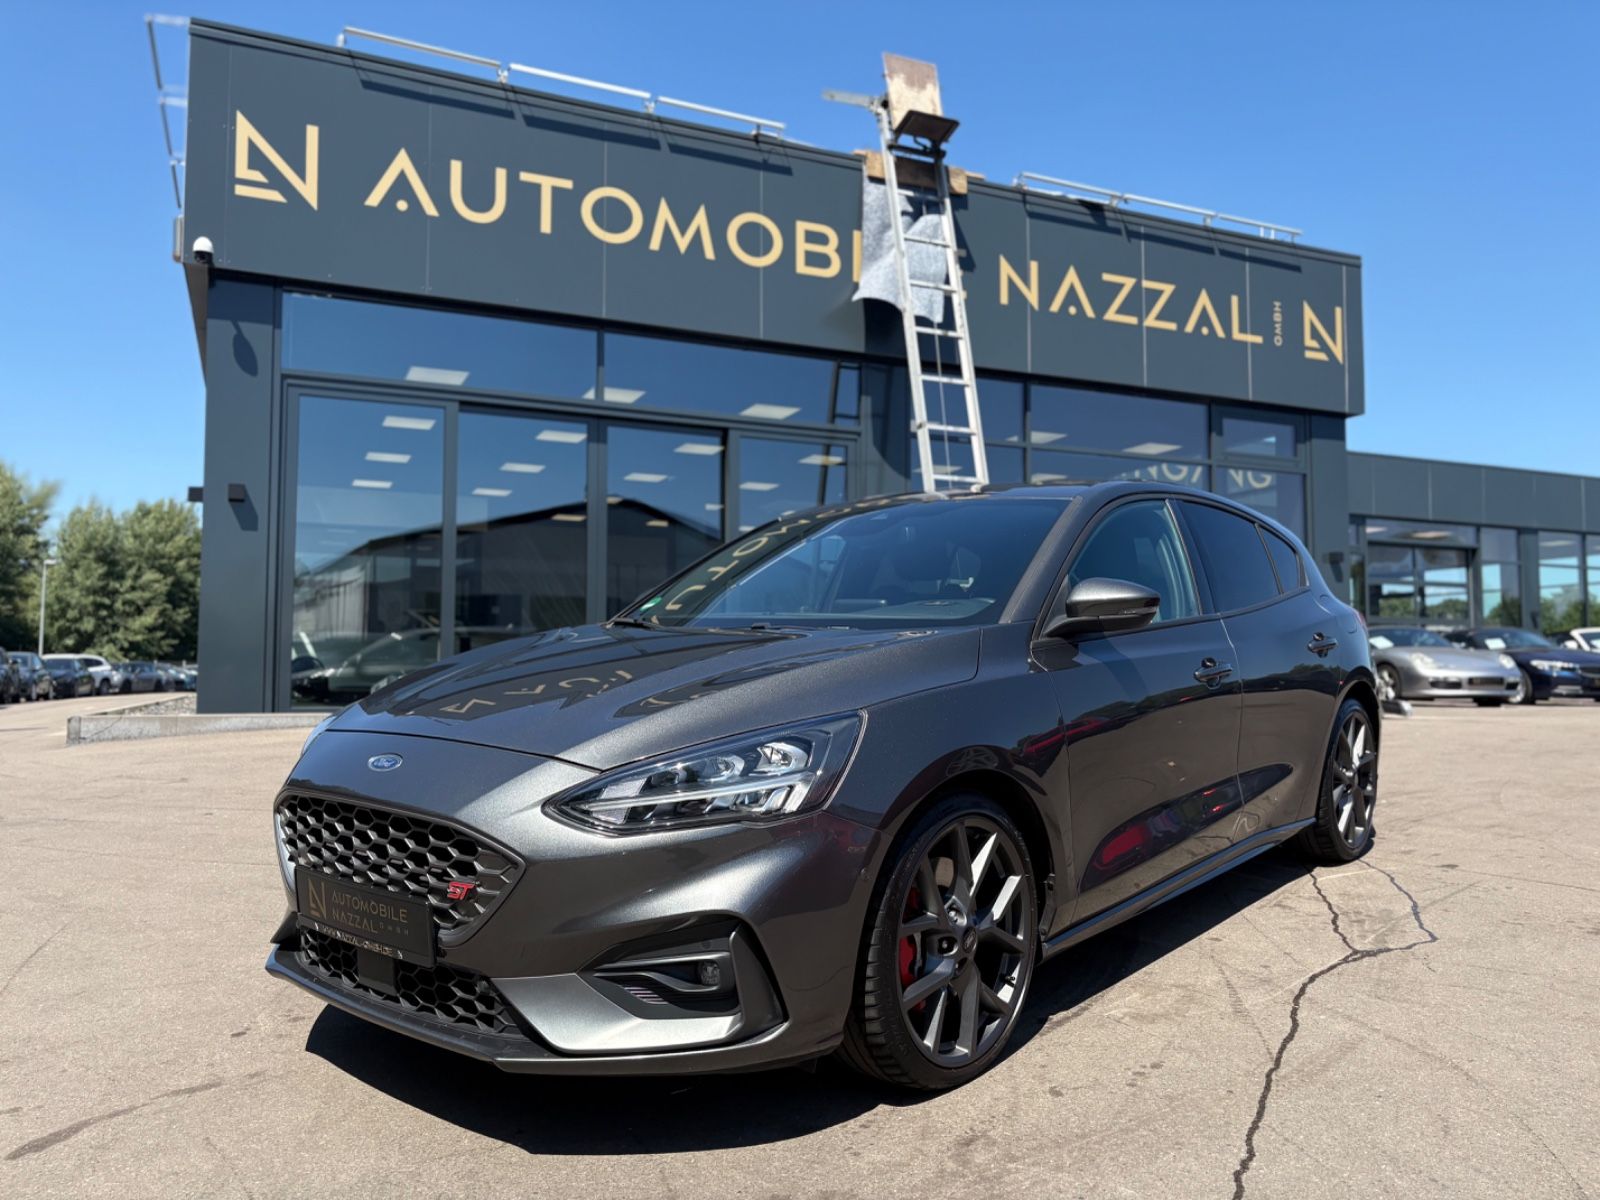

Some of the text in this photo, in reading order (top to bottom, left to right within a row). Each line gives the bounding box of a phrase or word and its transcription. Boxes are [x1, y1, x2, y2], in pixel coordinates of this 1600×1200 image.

[364, 147, 967, 299] AUTOMOBI
[999, 254, 1263, 344] NAZZAL
[447, 881, 475, 900] ST
[332, 891, 408, 923] AUTOMOBILE
[332, 910, 378, 934] NAZZAL
